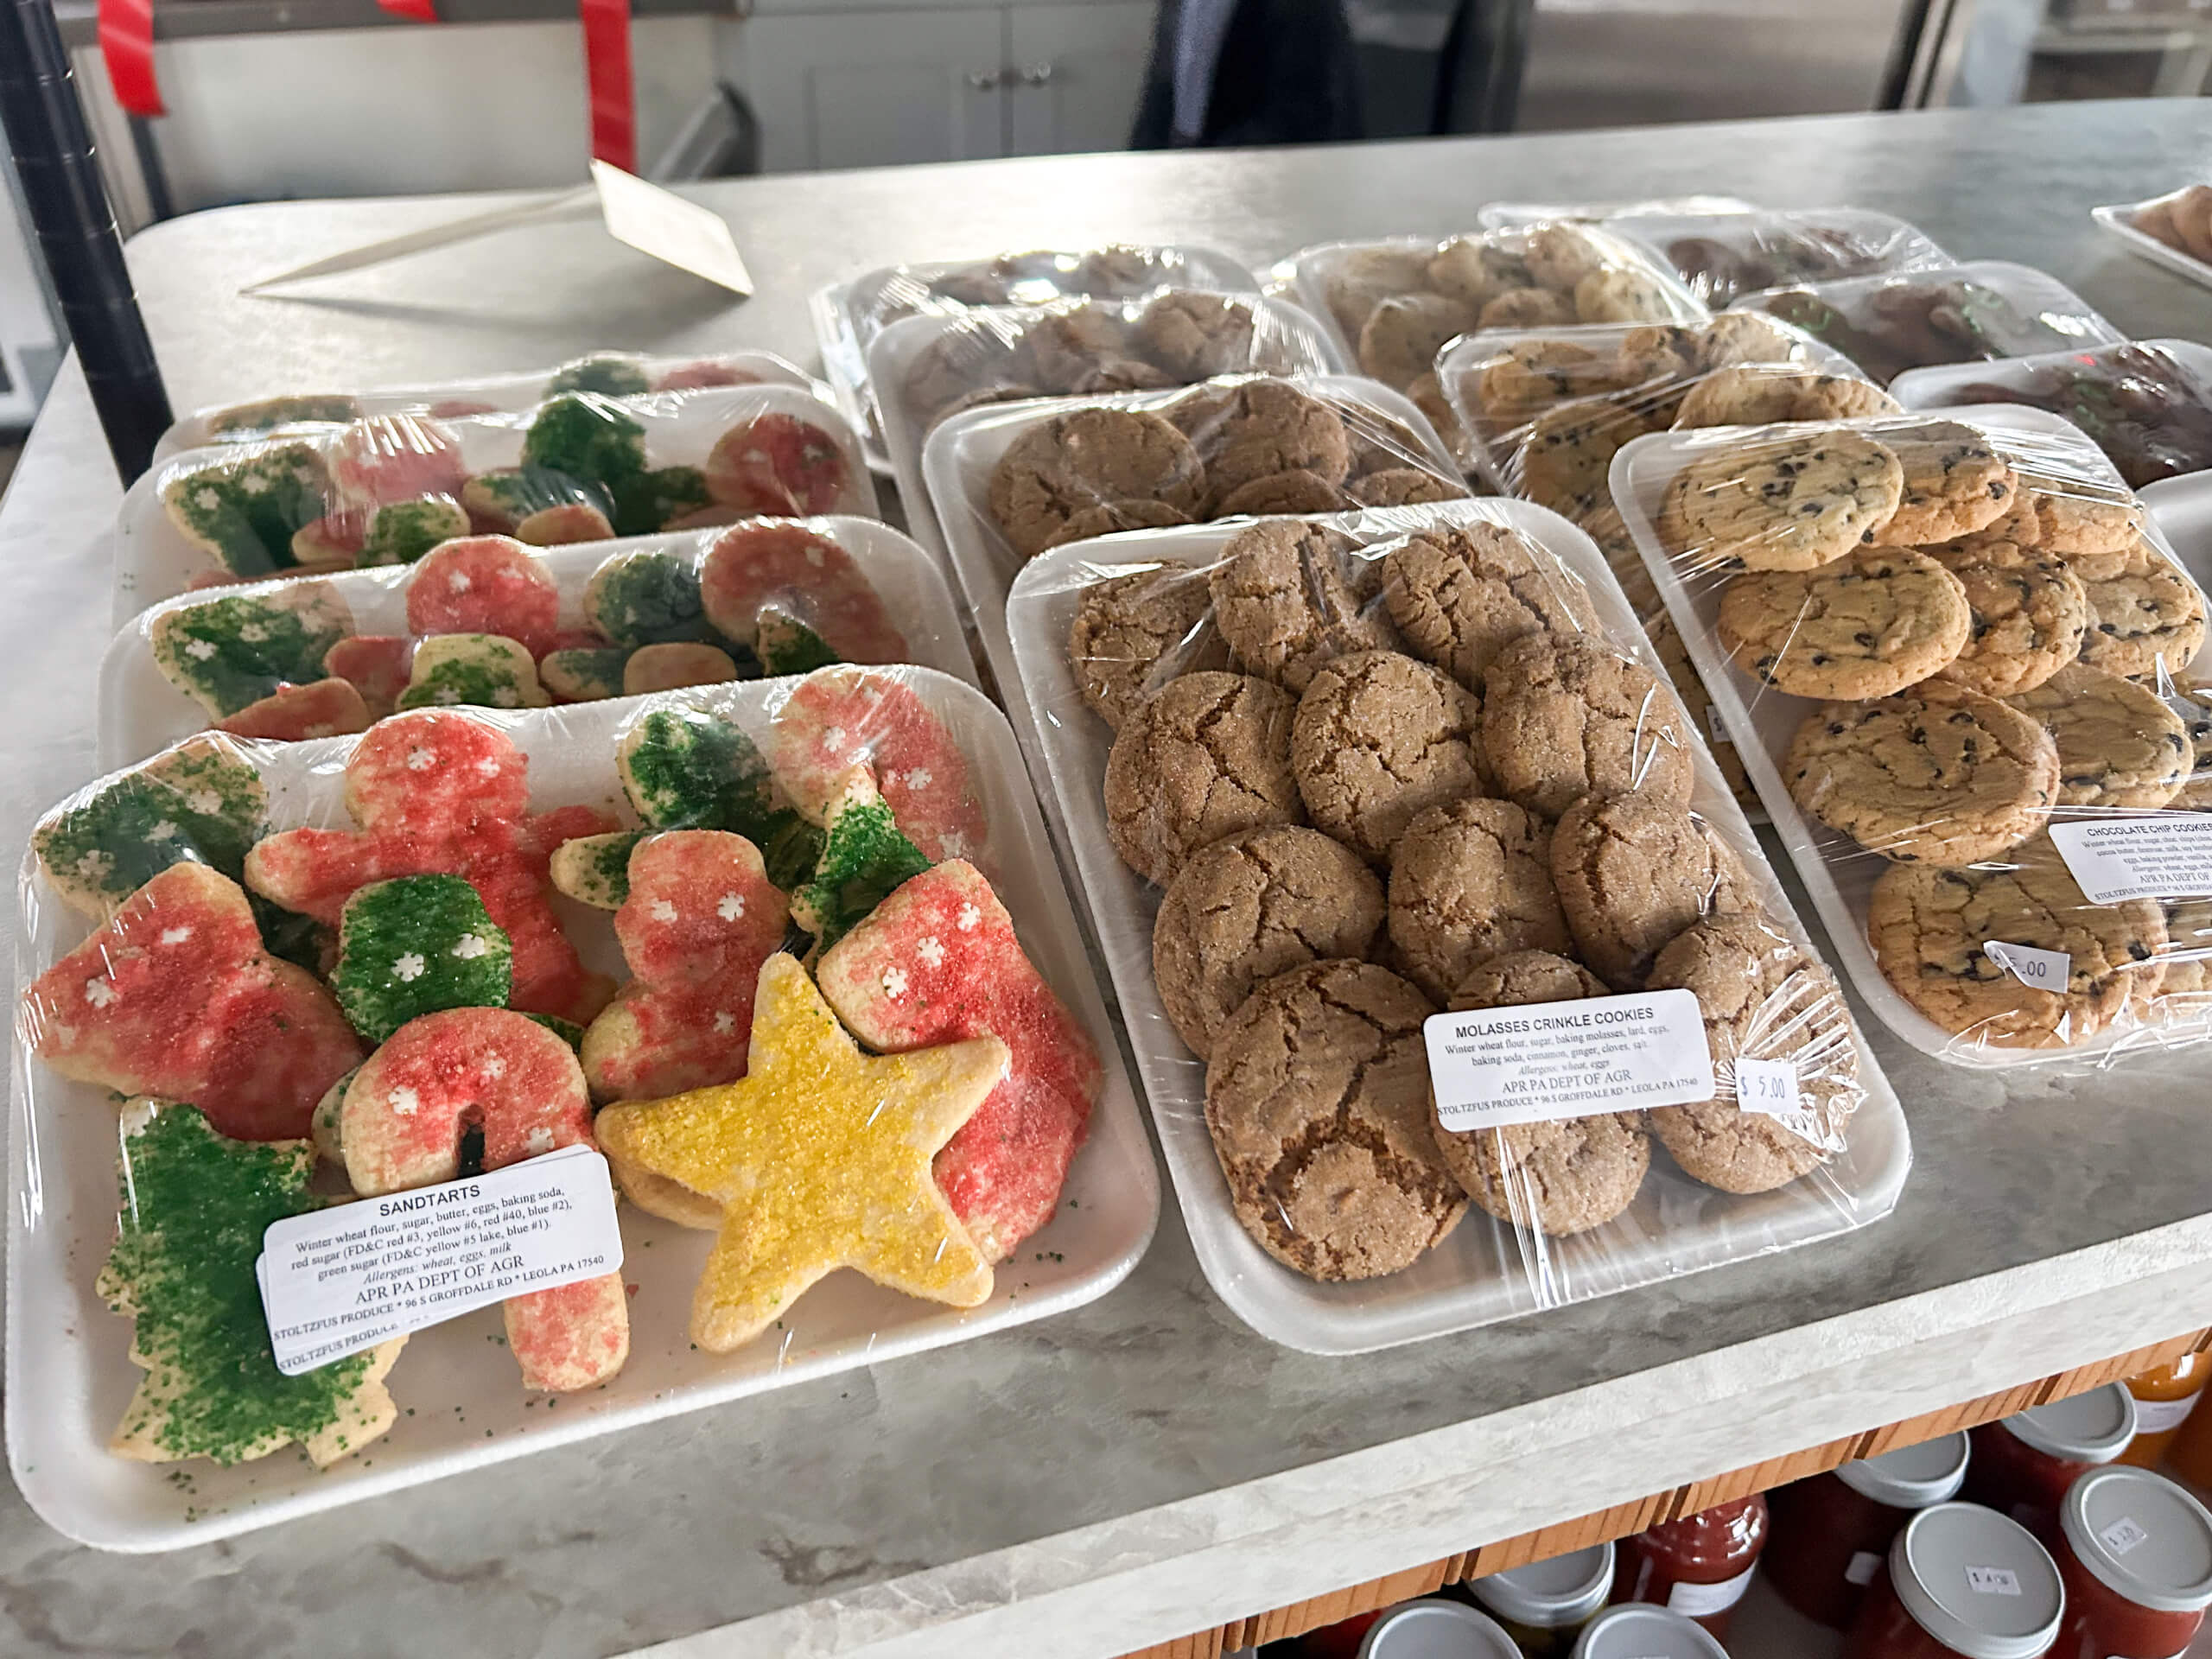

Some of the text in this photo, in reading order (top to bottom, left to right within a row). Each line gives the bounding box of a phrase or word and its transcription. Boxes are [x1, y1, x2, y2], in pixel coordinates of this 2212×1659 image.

[2087, 825, 2150, 837] CHOCOLATE
[2148, 824, 2171, 834] CHIP
[2094, 887, 2137, 900] STOLTZFUS
[2157, 874, 2173, 883] PA
[2171, 872, 2196, 882] DEPT
[2196, 872, 2209, 881] OF
[1455, 1007, 1654, 1039] MOLASSES CRINKLE COOKIES
[1445, 1044, 1476, 1055] Winter
[1477, 1040, 1504, 1052] wheat
[1554, 1033, 1585, 1045] baking
[1585, 1029, 1627, 1041] molasses,
[1471, 1055, 1502, 1066] baking
[1503, 1052, 1526, 1064] soda,
[1570, 1046, 1601, 1059] ginger,
[1502, 1069, 1632, 1094] APR PA DEPT OF AGR
[1740, 1076, 1785, 1099] $ 5.00
[1437, 1101, 1491, 1116] STOLTZFUS
[1491, 1096, 1534, 1109] PRODUCE
[1540, 1095, 1551, 1104] 96
[1551, 1094, 1558, 1103] S
[1558, 1088, 1610, 1103] GROFFDALE
[1610, 1086, 1624, 1096] RD
[1630, 1083, 1662, 1094] LEOLA
[1662, 1080, 1675, 1090] PA
[379, 1185, 480, 1217] SANDTARTS
[295, 1186, 565, 1254] Winter wheat flour, sugar, butter, eggs, baking soda,
[291, 1255, 309, 1271] red
[311, 1251, 340, 1266] sugar
[343, 1239, 384, 1260] (FD&C
[386, 1234, 404, 1249] red
[407, 1231, 424, 1243] #3,
[426, 1225, 461, 1243] yellow
[483, 1213, 500, 1227] red
[502, 1209, 526, 1222] #40,
[527, 1205, 550, 1217] blue
[317, 1265, 347, 1282] green
[350, 1257, 378, 1272] sugar
[381, 1246, 422, 1266] (FD&C
[425, 1240, 461, 1257] yellow
[463, 1234, 477, 1245] #5
[479, 1230, 505, 1243] lake,
[506, 1224, 529, 1236] blue
[363, 1265, 415, 1285] Allergens:
[422, 1255, 456, 1270] wheat,
[489, 1241, 512, 1256] milk
[355, 1255, 524, 1305] APR PA DEPT OF AGR
[274, 1317, 338, 1341] STOLTZFUS
[340, 1303, 394, 1325] PRODUCE
[404, 1299, 417, 1309] 96
[419, 1295, 427, 1306] S
[429, 1280, 494, 1303] GROFFDALE
[496, 1276, 513, 1288] RD
[522, 1267, 559, 1282] LEOLA
[560, 1262, 575, 1273] PA
[577, 1255, 604, 1269] 17540
